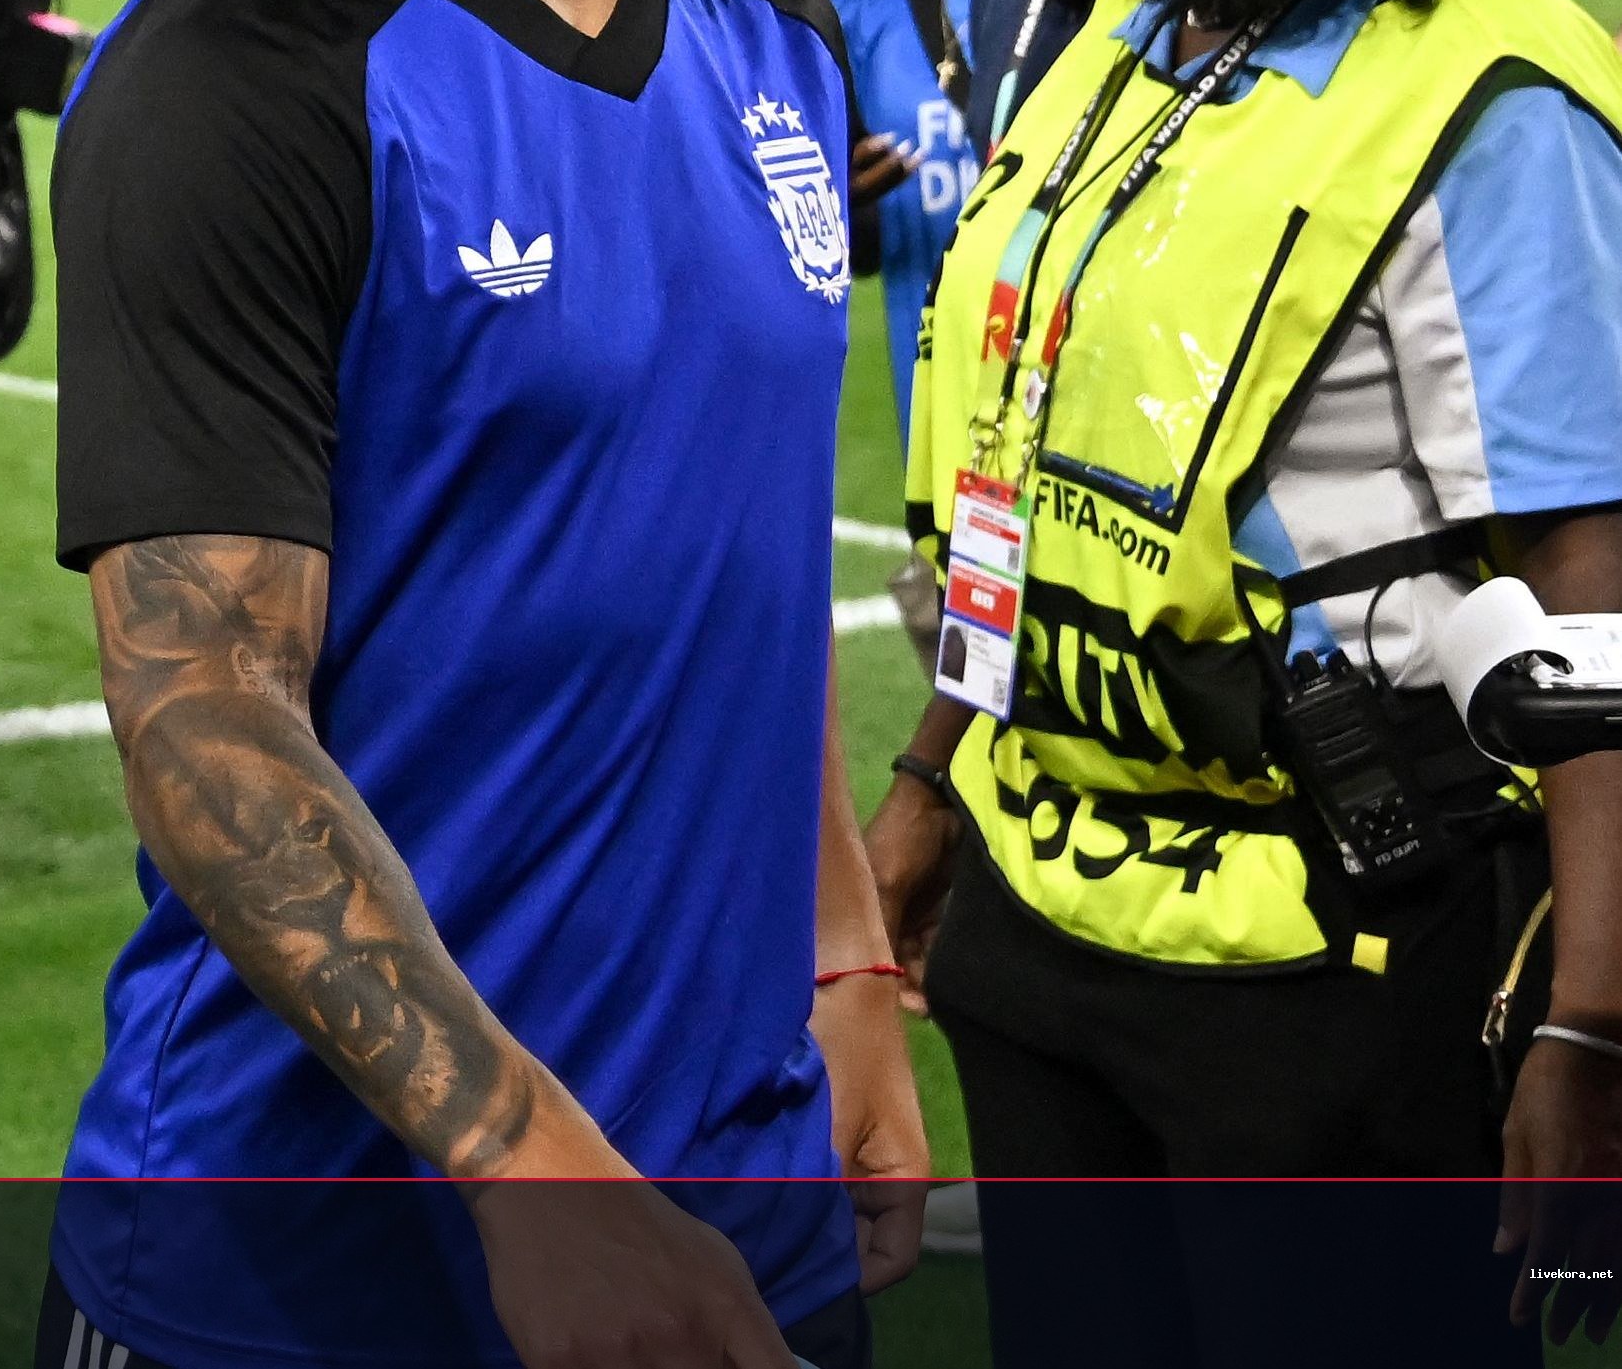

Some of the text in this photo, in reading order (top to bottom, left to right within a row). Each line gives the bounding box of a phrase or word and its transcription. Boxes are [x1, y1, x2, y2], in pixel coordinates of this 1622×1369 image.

[1153, 74, 1216, 145] WORLD
[1213, 34, 1251, 76] CUP
[787, 181, 834, 251] AFA
[1033, 478, 1171, 576] FIFA.com
